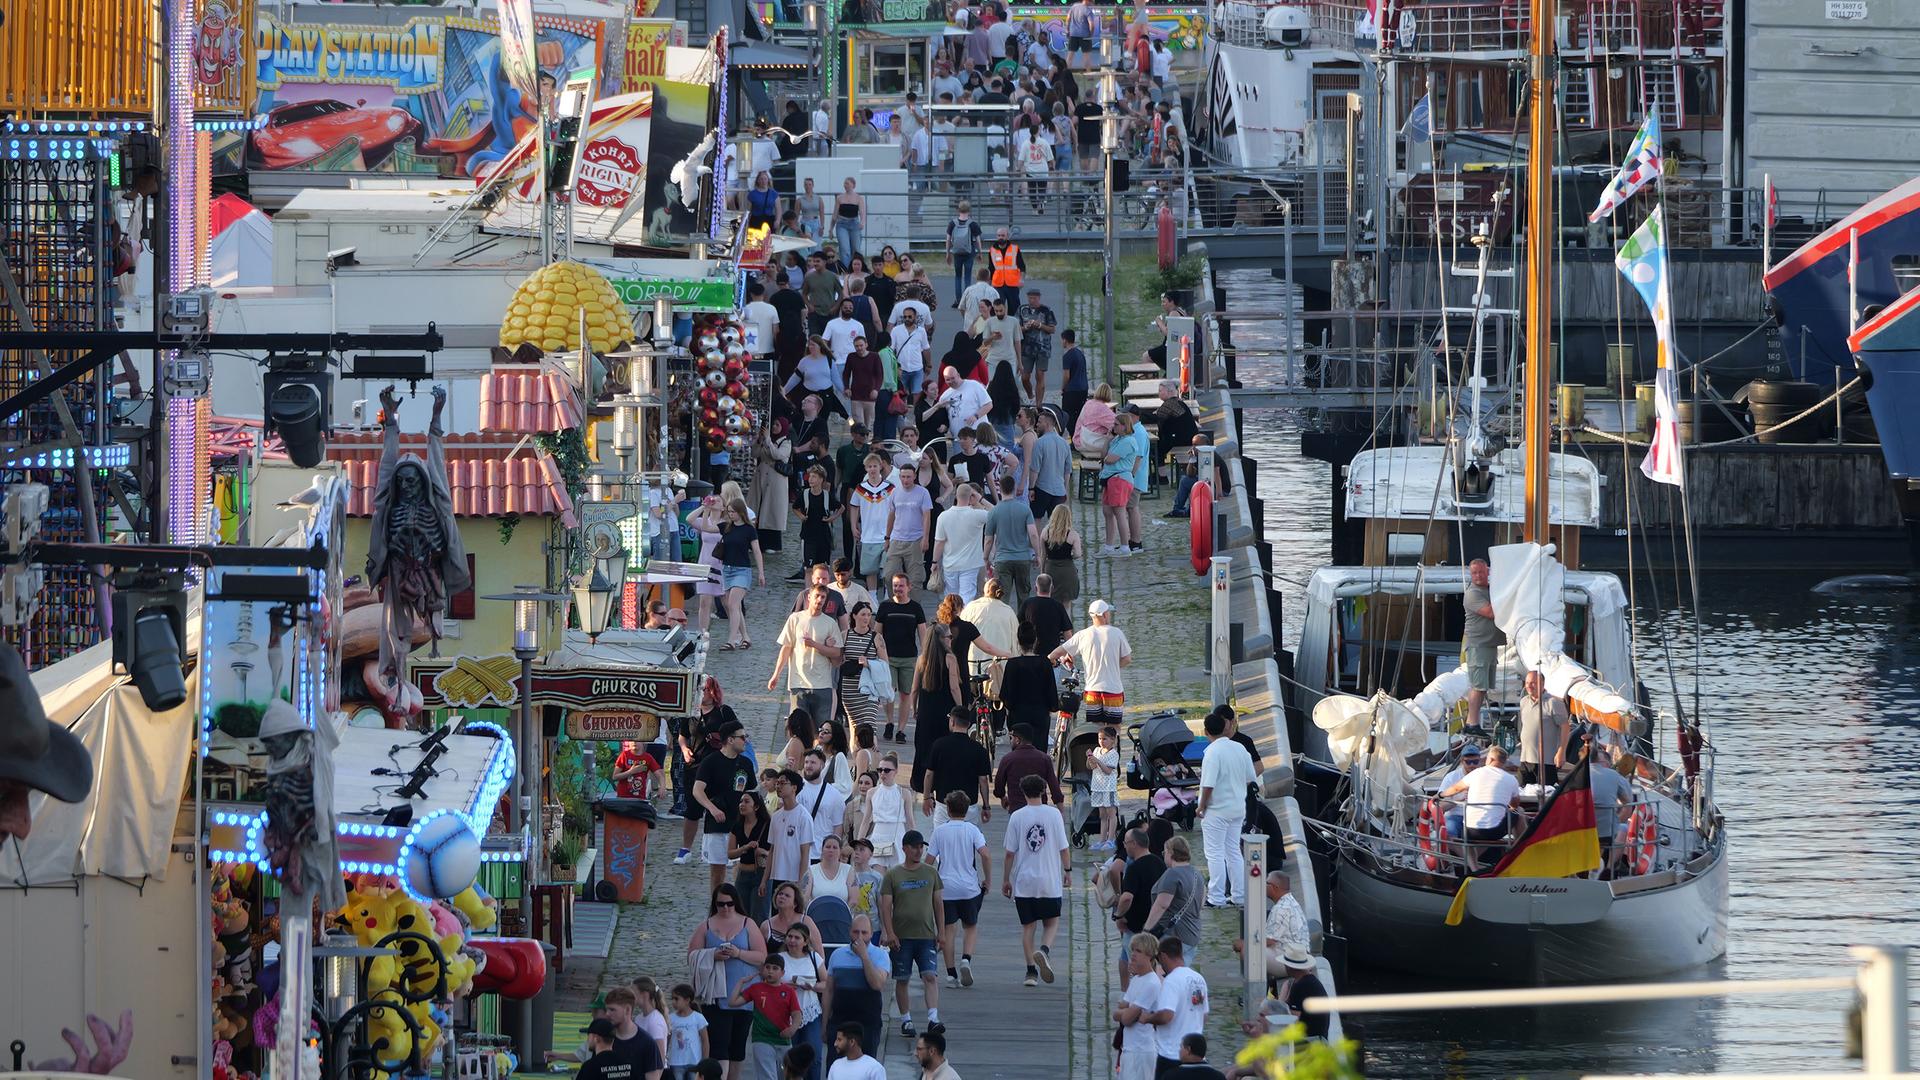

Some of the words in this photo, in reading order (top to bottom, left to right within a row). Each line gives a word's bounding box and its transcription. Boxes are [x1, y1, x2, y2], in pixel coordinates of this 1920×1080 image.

[884, 0, 929, 20] BEAST
[626, 28, 653, 48] iße
[256, 18, 320, 77] PLAY
[326, 23, 439, 82] STATION
[588, 146, 634, 169] KOHRT
[580, 163, 634, 189] RIGINA
[580, 183, 597, 201] seit
[1614, 528, 1628, 537] 180
[592, 679, 657, 699] CHURROS
[582, 713, 643, 731] CHURROS
[760, 995, 767, 1009] 7
